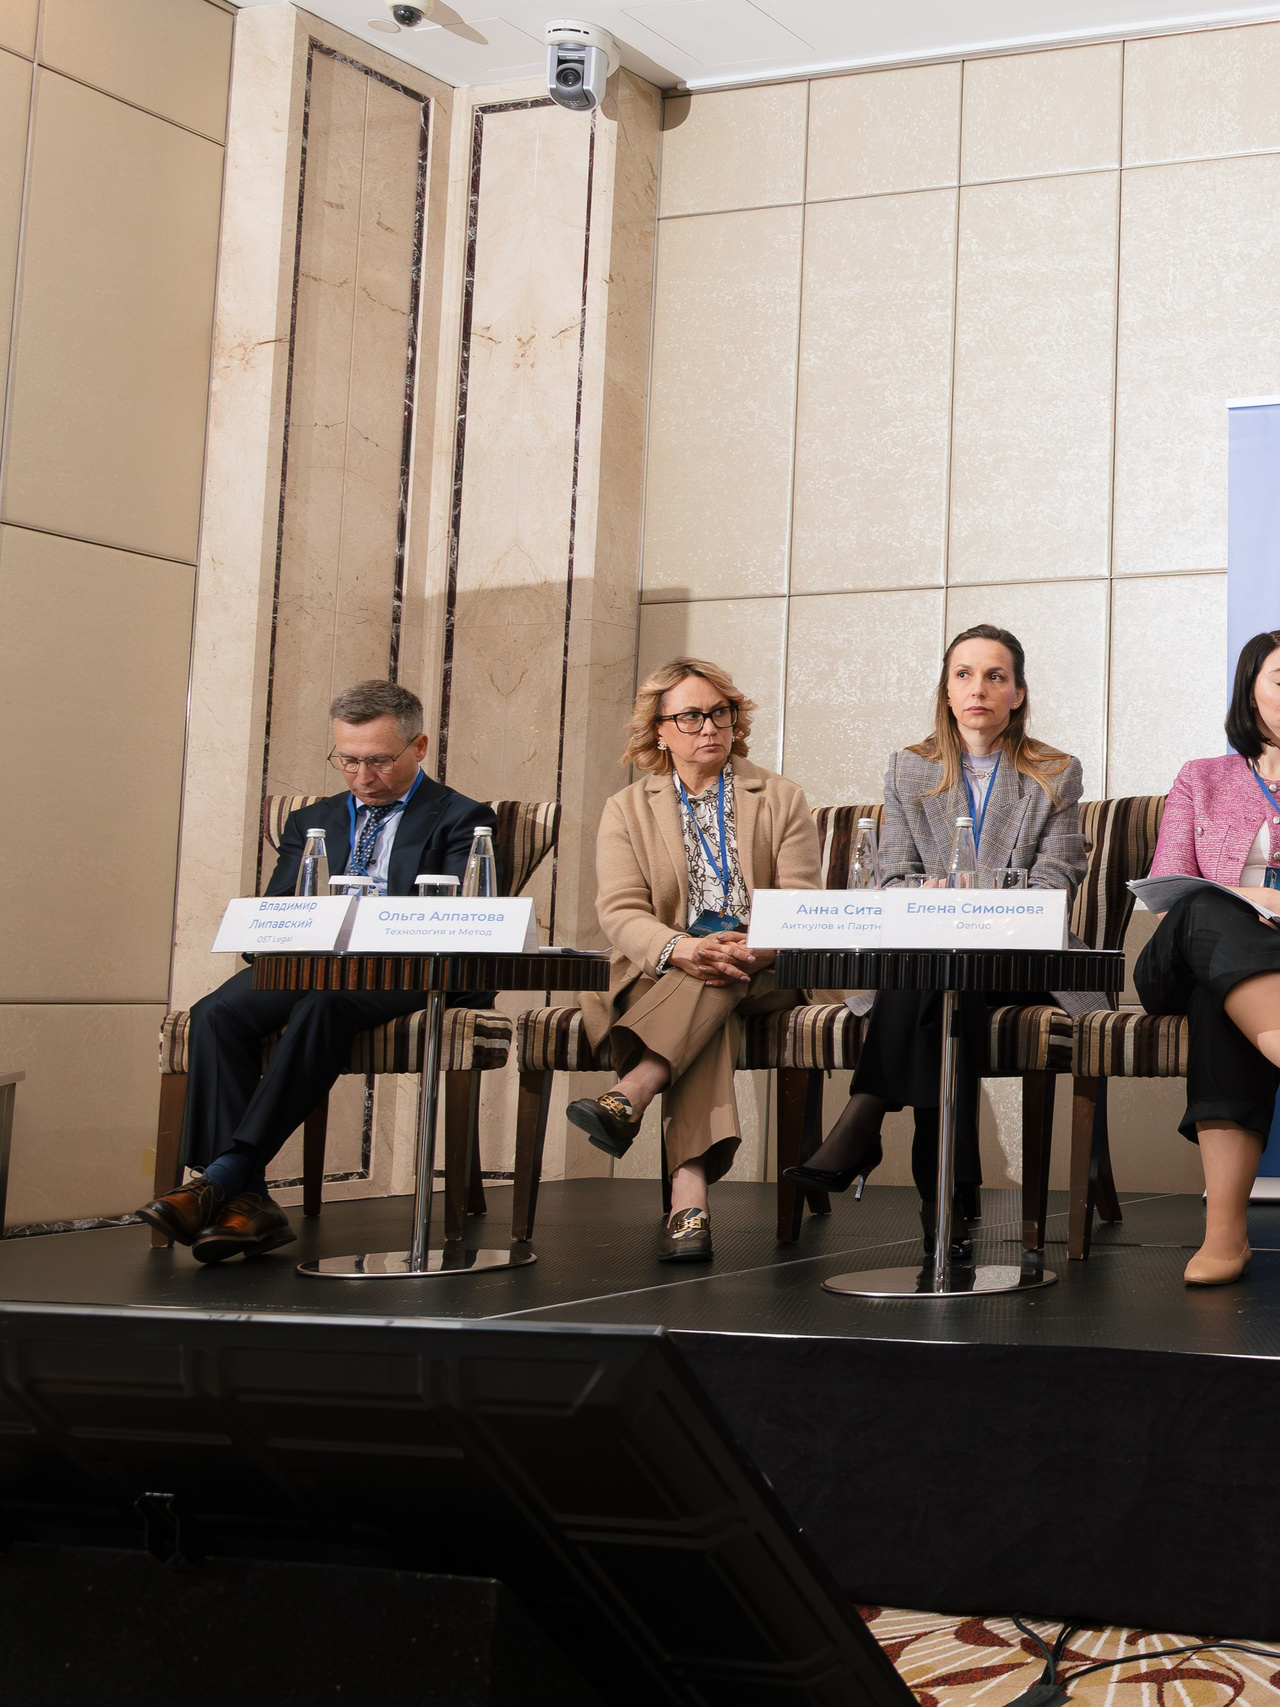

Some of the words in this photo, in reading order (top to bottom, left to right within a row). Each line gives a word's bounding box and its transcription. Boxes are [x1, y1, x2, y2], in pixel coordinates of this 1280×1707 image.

[259, 901, 318, 913] Владимир
[796, 904, 839, 915] Анна
[906, 902, 956, 914] Елена
[961, 903, 1044, 915] Симонова
[378, 910, 425, 922] Ольга
[429, 911, 505, 922] Алпатова
[248, 918, 313, 930] Липавский
[837, 923, 844, 931] и
[385, 928, 446, 936] Технология
[458, 929, 493, 937] Метод
[272, 935, 294, 945] Legal
